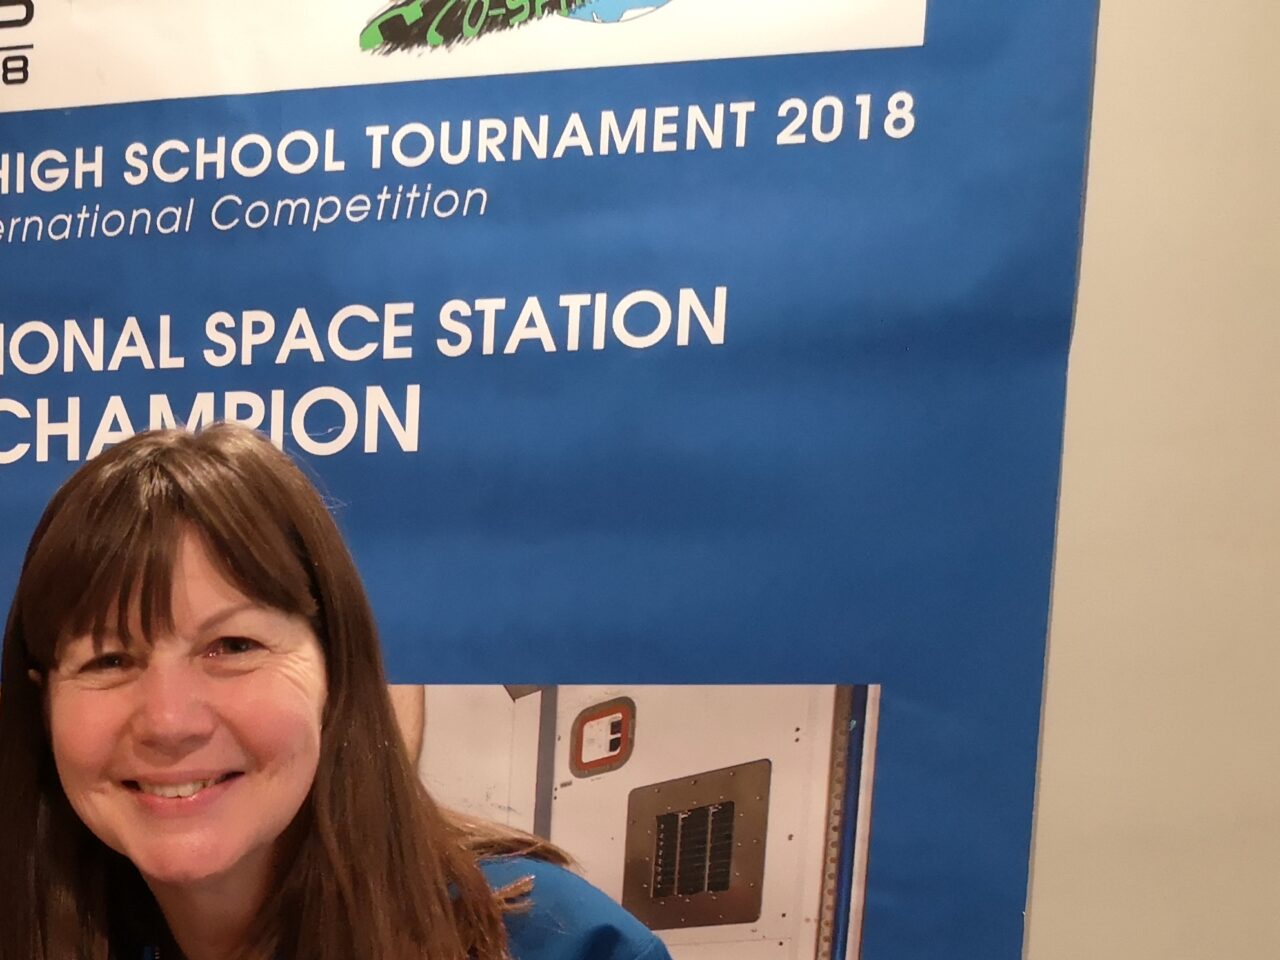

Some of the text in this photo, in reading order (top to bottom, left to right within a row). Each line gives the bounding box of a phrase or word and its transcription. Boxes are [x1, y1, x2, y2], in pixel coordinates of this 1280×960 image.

[123, 130, 345, 184] SCHOOL
[365, 102, 755, 170] TOURNAMENT
[776, 92, 916, 146] 2018
[210, 184, 490, 231] Competition
[204, 303, 415, 367] SPACE
[436, 286, 728, 358] STATION
